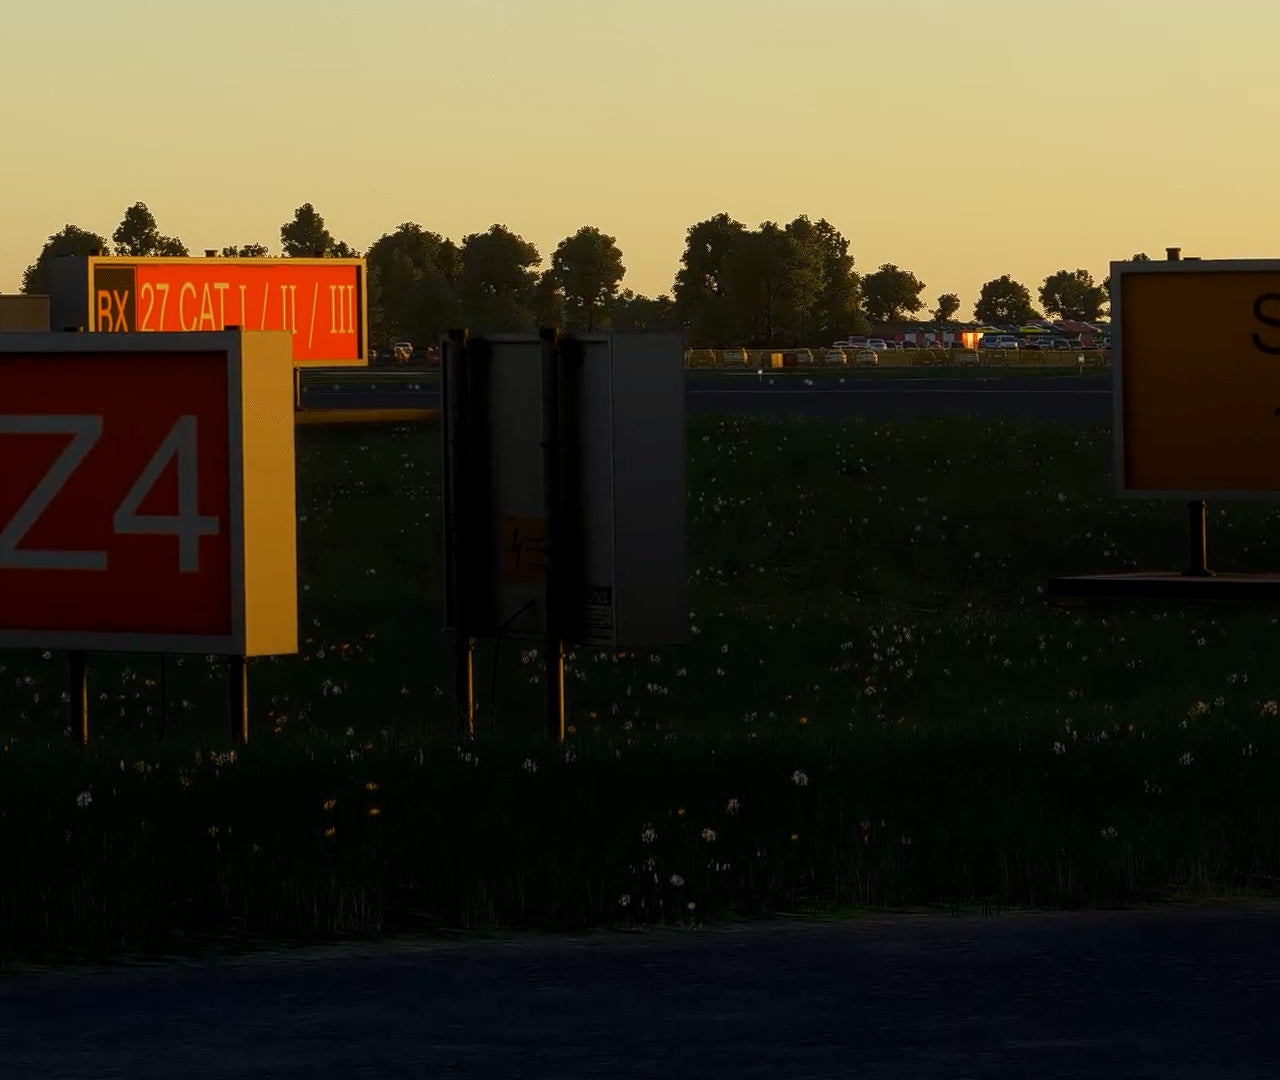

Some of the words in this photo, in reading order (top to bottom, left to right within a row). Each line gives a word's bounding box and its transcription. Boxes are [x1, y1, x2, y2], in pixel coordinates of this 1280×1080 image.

[141, 282, 170, 332] 27
[178, 282, 230, 332] CAT
[280, 284, 297, 333] II
[329, 284, 355, 334] III
